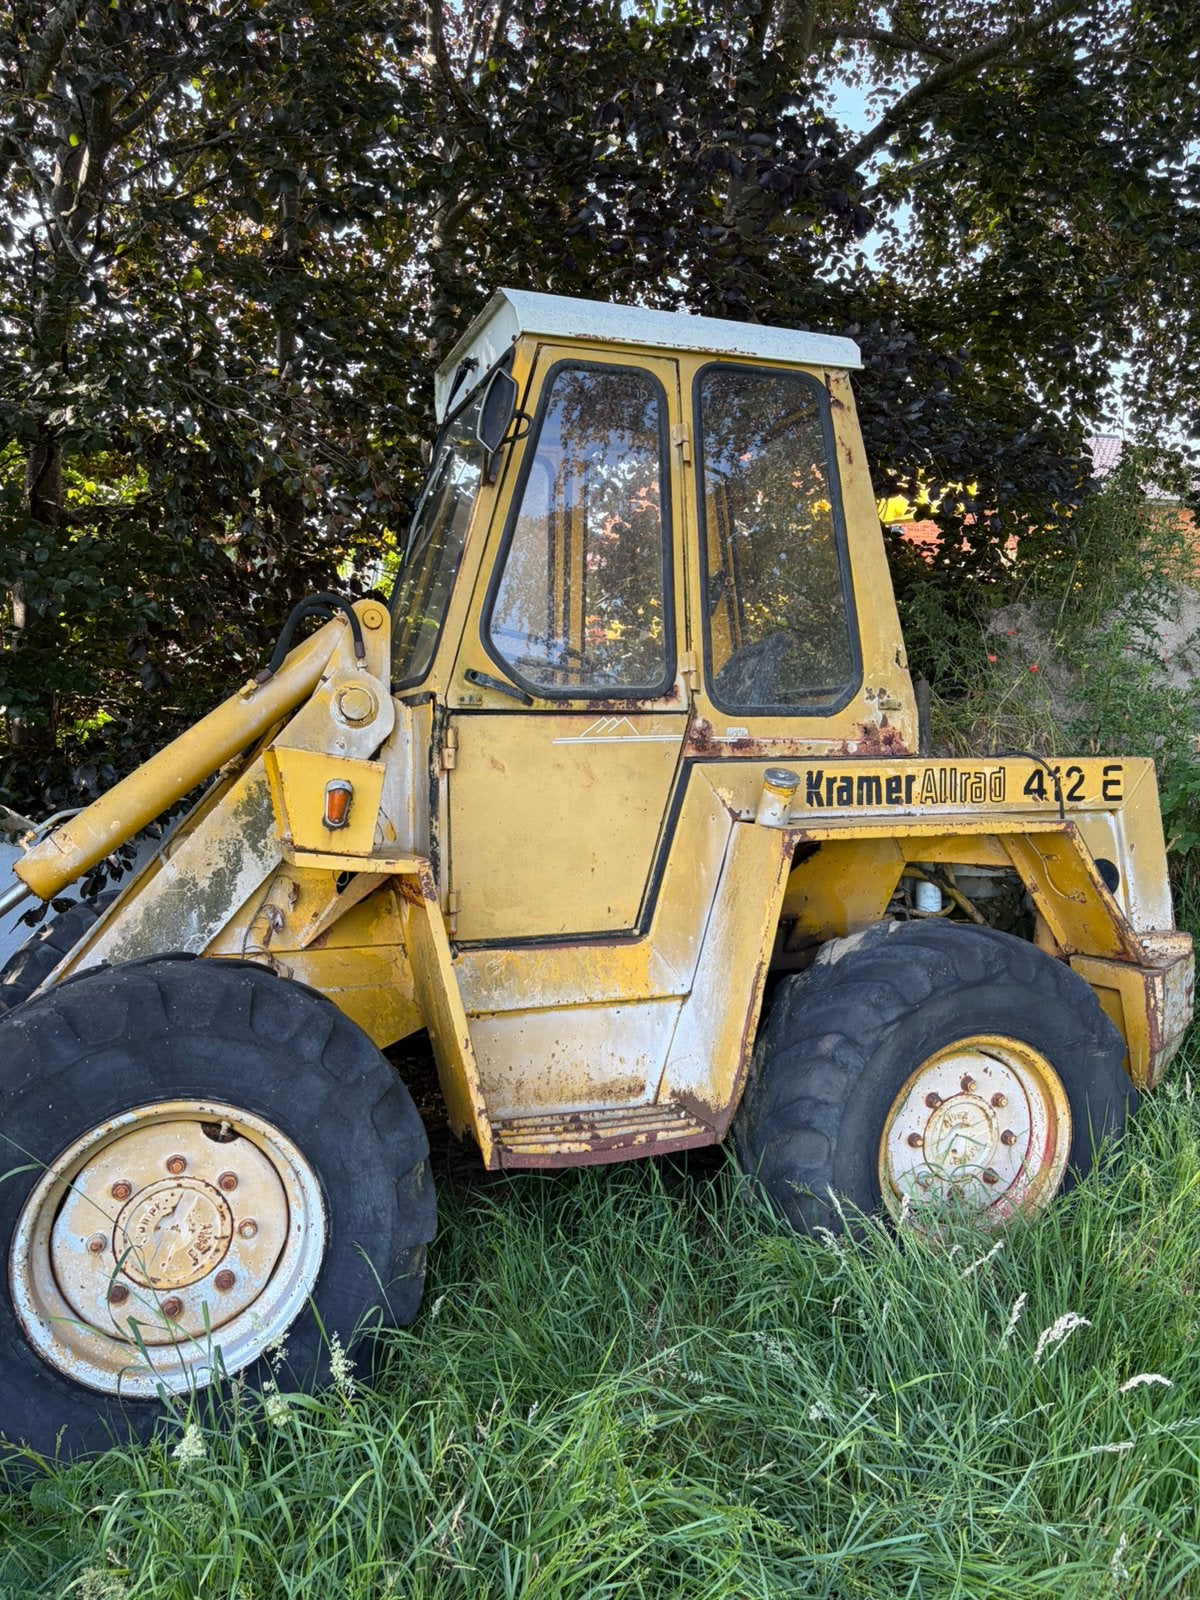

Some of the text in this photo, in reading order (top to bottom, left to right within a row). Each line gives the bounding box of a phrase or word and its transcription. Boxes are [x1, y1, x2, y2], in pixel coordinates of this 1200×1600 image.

[806, 765, 1123, 807] Kramer Allrad 412 E
